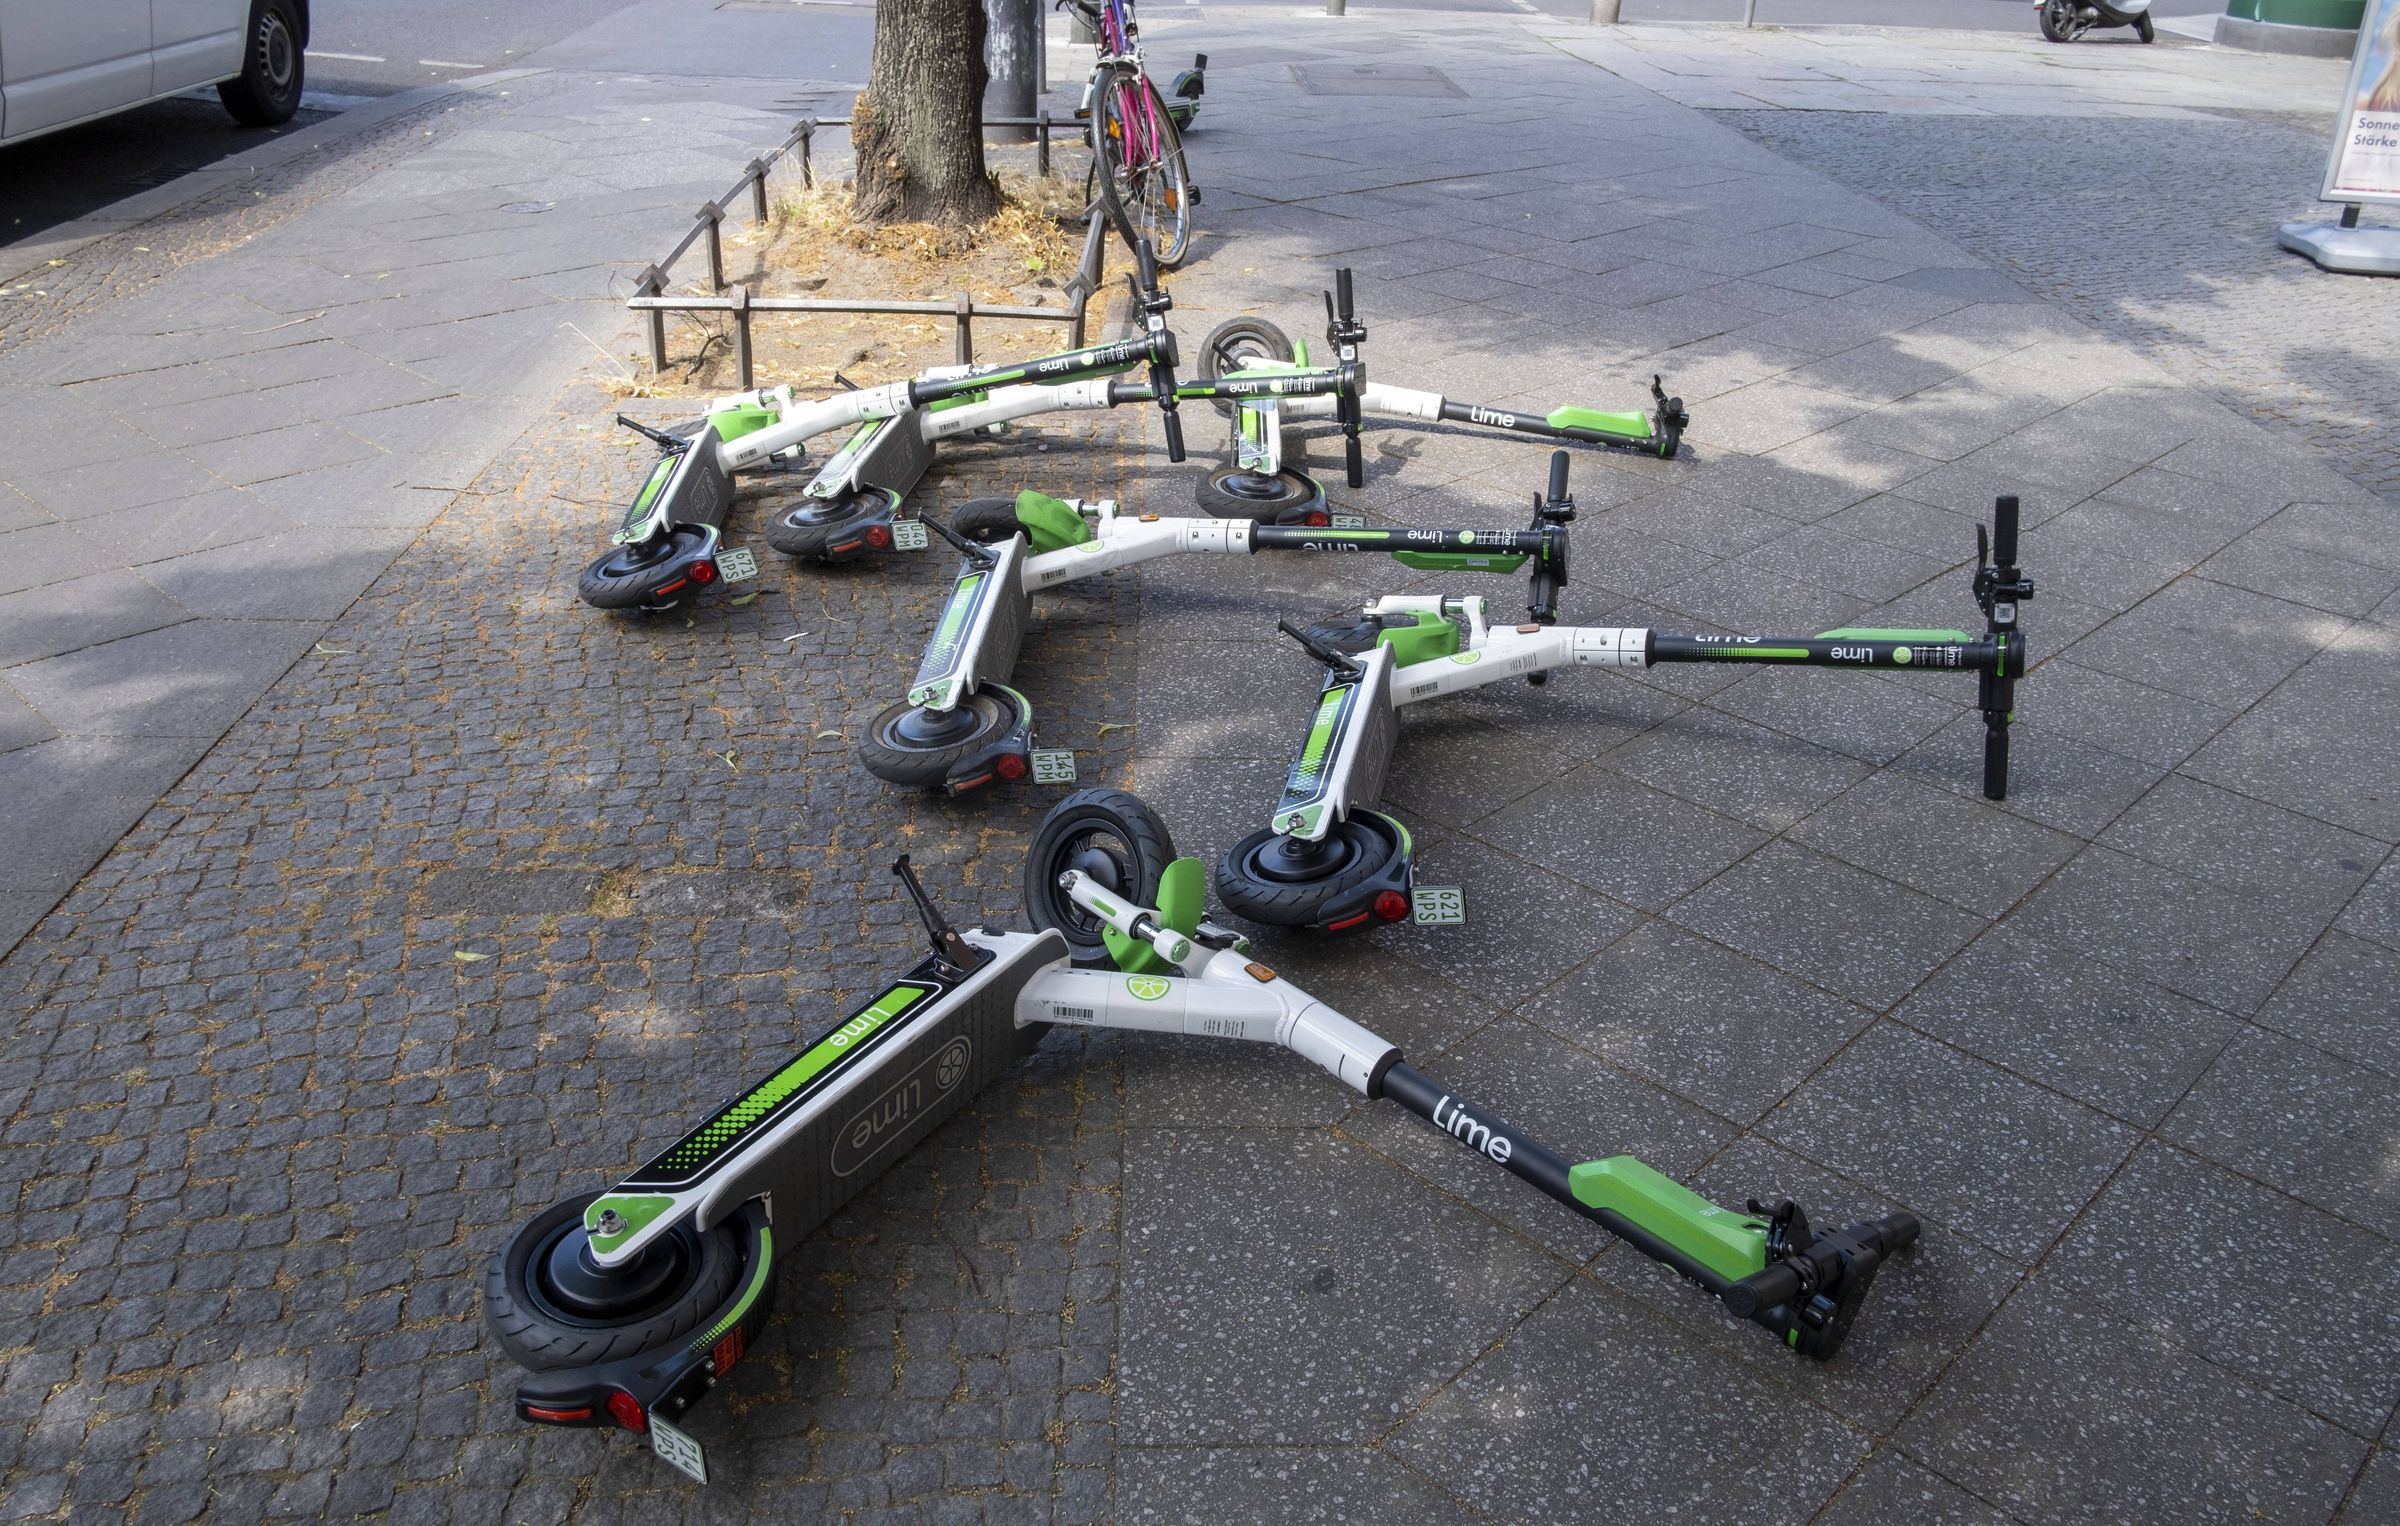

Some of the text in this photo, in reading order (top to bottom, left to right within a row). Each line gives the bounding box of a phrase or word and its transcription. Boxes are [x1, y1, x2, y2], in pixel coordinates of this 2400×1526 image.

[2353, 134, 2398, 148] Stärke
[1039, 358, 1070, 373] Lime
[1229, 382, 1258, 394] Lime
[1470, 405, 1516, 427] Lime
[895, 525, 912, 548] WPM
[1407, 529, 1443, 543] Lime
[719, 555, 739, 580] WPS
[735, 552, 755, 575] 671
[1830, 646, 1873, 663] Lime
[1035, 754, 1055, 780] WPM
[1416, 892, 1437, 921] WPS
[1439, 892, 1461, 920] 621
[828, 1007, 892, 1047] Lime
[851, 1079, 921, 1149] Lime
[1432, 1095, 1512, 1163] Lime
[653, 1421, 677, 1461] WPS
[676, 1437, 701, 1476] 714
